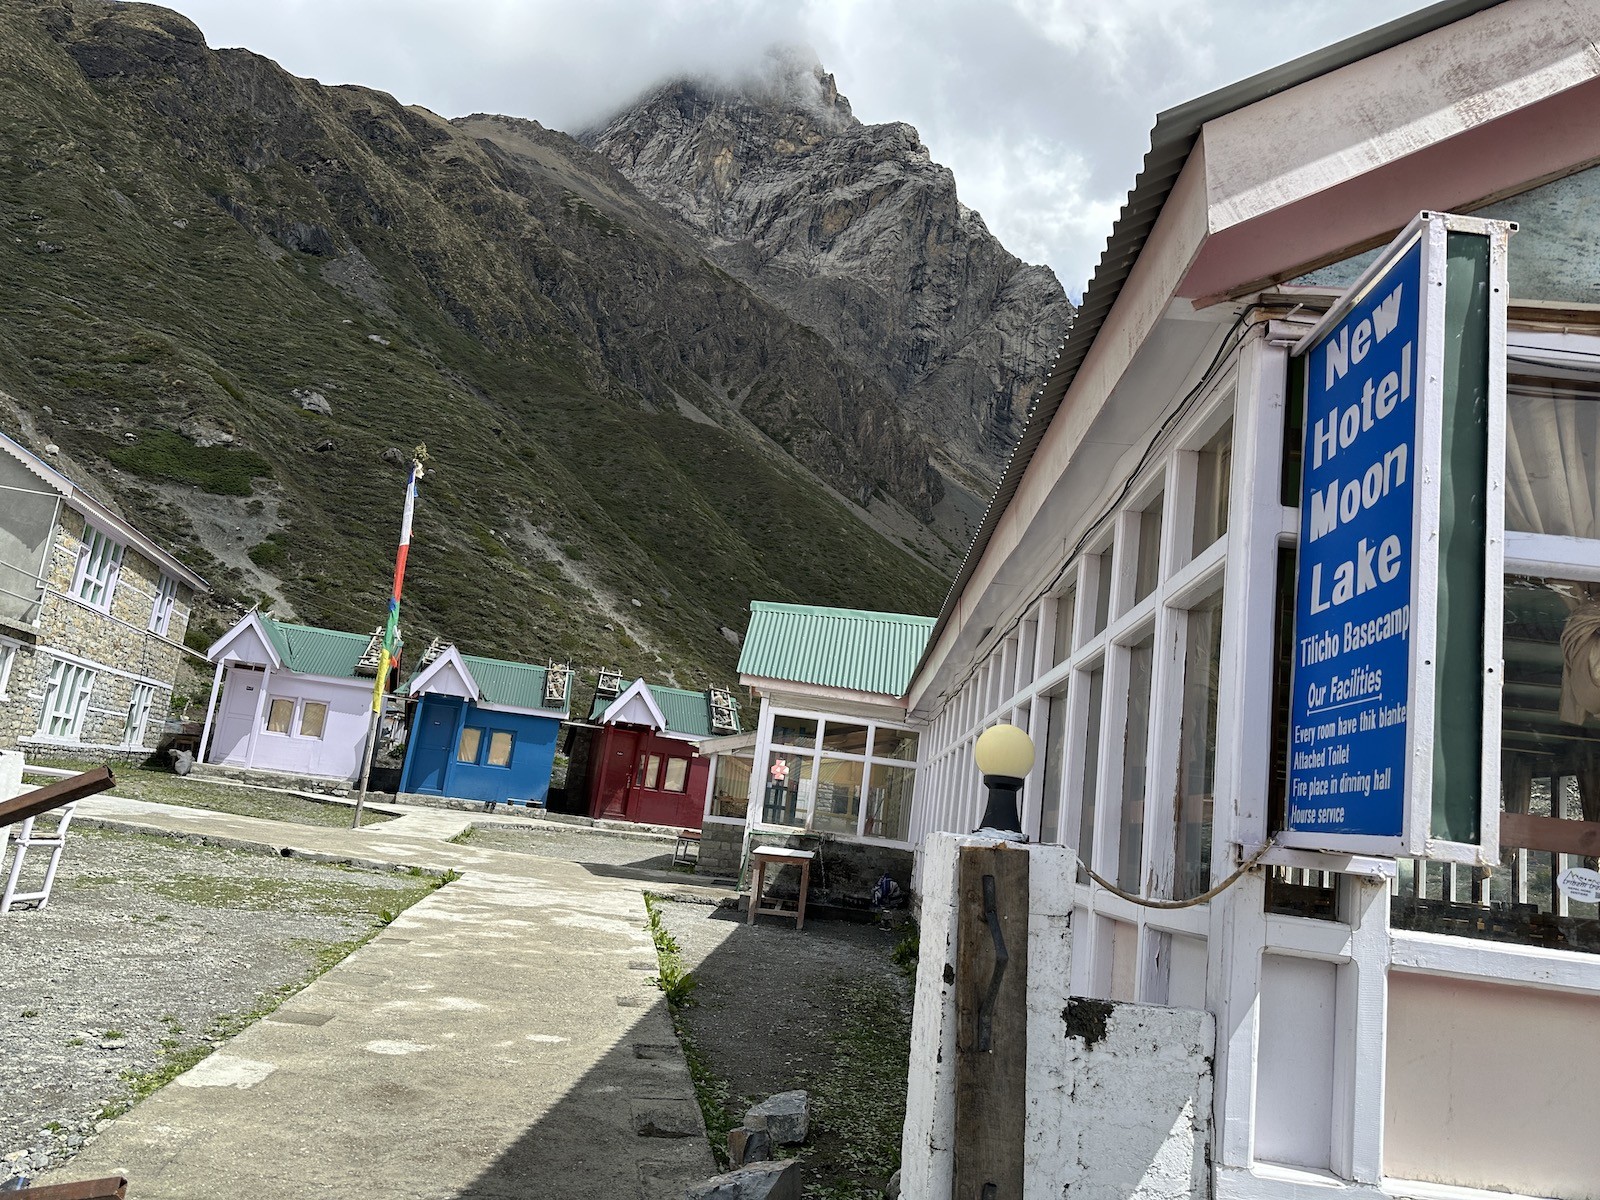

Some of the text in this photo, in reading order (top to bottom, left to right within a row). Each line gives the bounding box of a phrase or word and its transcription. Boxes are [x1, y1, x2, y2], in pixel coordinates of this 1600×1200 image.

[1326, 282, 1403, 392] New
[1313, 340, 1412, 471] Hotel
[1309, 443, 1408, 544] Moon
[1310, 534, 1401, 616] Lake
[1300, 604, 1410, 668] Tilicho Basecamp
[1307, 664, 1382, 709] Our Facilities
[1294, 702, 1408, 746] Every room have thik blanke
[1292, 767, 1392, 801] Fire place in dinning hall
[1293, 744, 1350, 770] Attached Toilet
[1290, 803, 1345, 824] Hourse service
